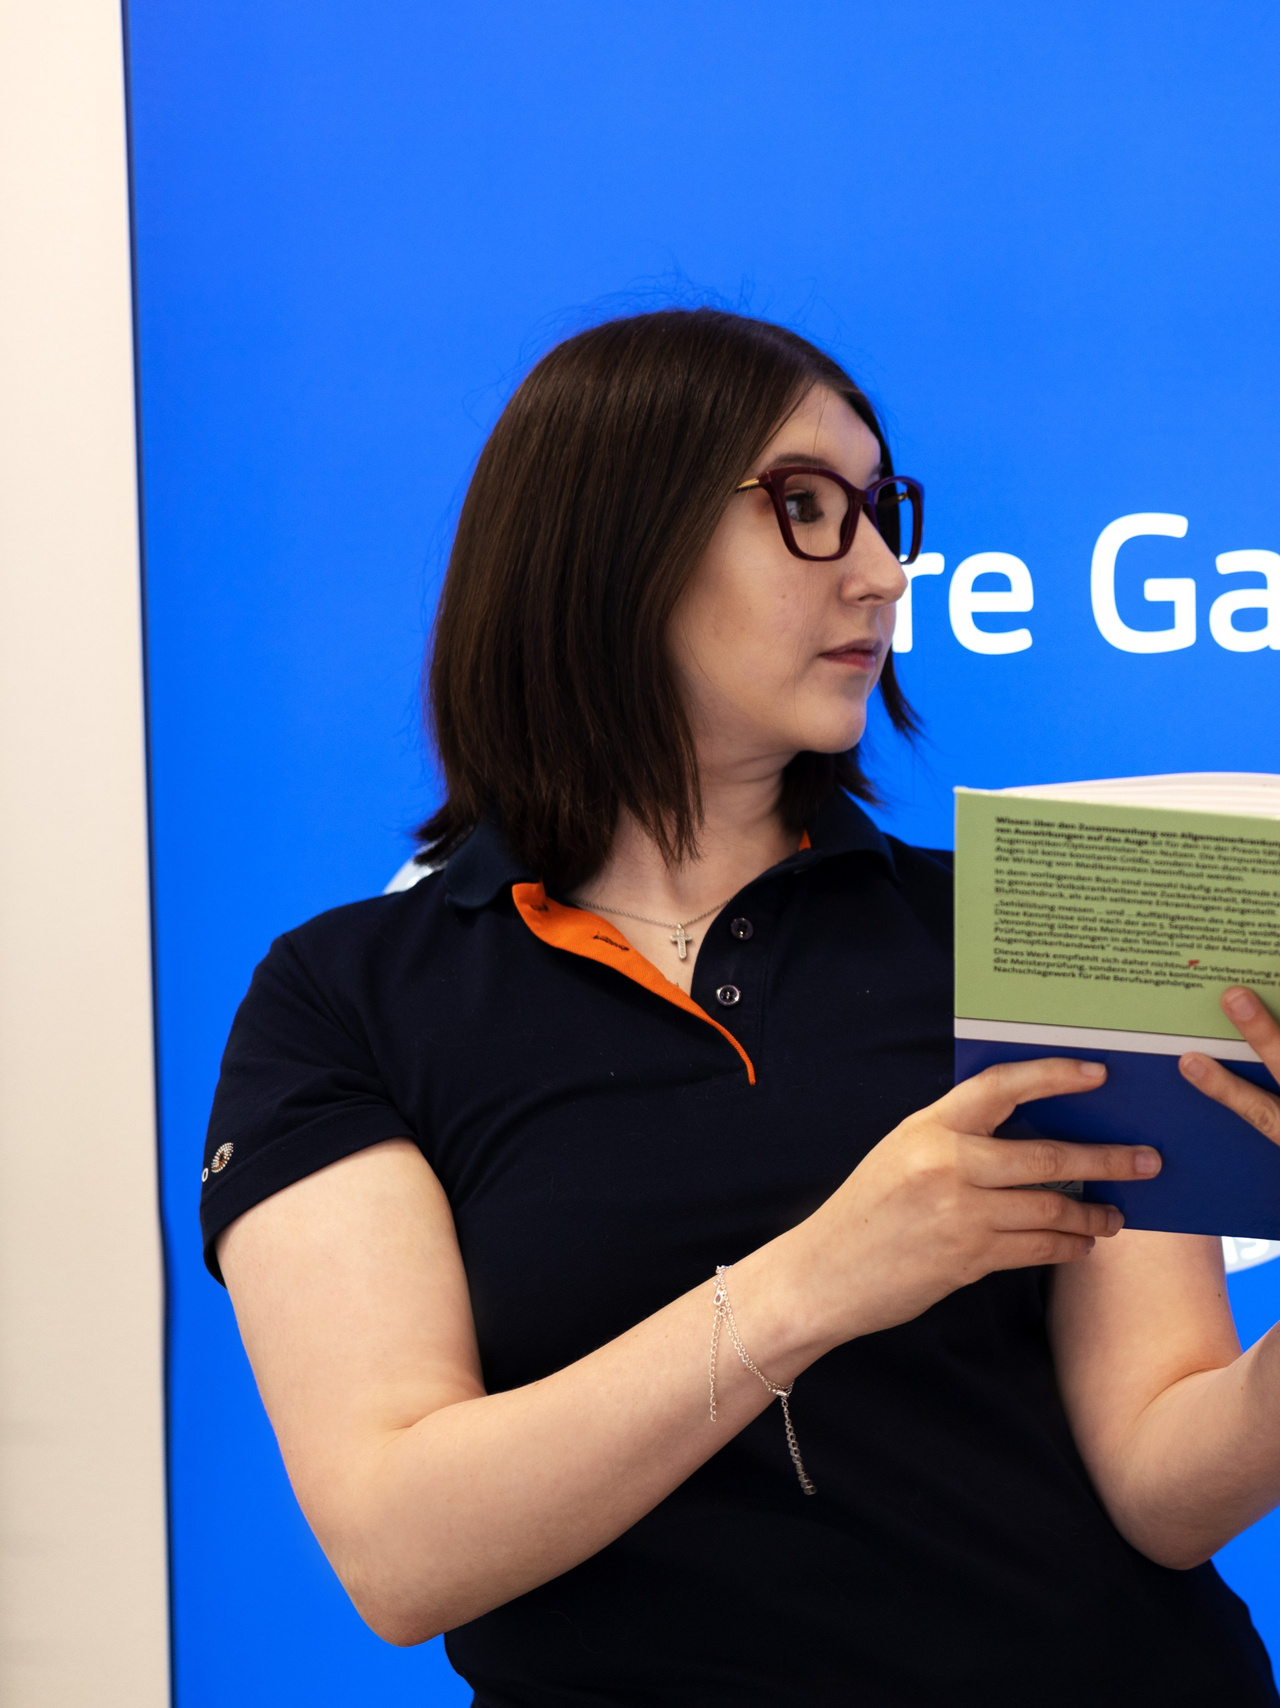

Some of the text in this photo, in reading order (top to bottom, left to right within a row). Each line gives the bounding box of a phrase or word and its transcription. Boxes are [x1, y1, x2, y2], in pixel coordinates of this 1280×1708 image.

[892, 552, 1034, 655] re
[995, 817, 1030, 826] Wissen
[1033, 820, 1055, 828] über
[1058, 822, 1076, 830] den
[1105, 835, 1121, 843] das
[1124, 837, 1148, 847] Auge
[1165, 840, 1178, 848] für
[1181, 841, 1200, 850] den
[1214, 844, 1228, 852] der
[1160, 849, 1196, 859] Nutzen.
[1198, 852, 1214, 860] Die
[995, 854, 1009, 862] die
[1012, 856, 1053, 868] Wirkung
[1206, 873, 1243, 882] werden.
[996, 845, 1025, 855] Auges
[1041, 849, 1067, 858] keine
[1069, 851, 1117, 862] konstante
[1119, 855, 1151, 866] Größe,
[1153, 859, 1193, 868] sondern
[1195, 862, 1219, 870] kann
[1221, 864, 1248, 873] durch
[1007, 869, 1028, 877] dem
[1095, 876, 1119, 884] Buch
[1121, 878, 1141, 886] sind
[1143, 881, 1178, 889] sowohl
[1179, 883, 1211, 894] häufig
[1008, 879, 1053, 888] genannte
[1140, 889, 1157, 897] wie
[1241, 897, 1280, 908] Rheuma
[1069, 892, 1082, 900] als
[1084, 894, 1107, 902] auch
[1109, 896, 1153, 906] seltenere
[995, 908, 1020, 917] Diese
[1022, 910, 1075, 921] Kenntnisse
[1077, 915, 1097, 923] sind
[1124, 919, 1139, 927] der
[1168, 922, 1220, 933] September
[1058, 905, 1094, 914] messen
[1207, 916, 1224, 925] des
[1226, 918, 1255, 928] Auges
[1057, 922, 1078, 930] über
[1081, 924, 1097, 932] das
[1229, 937, 1248, 945] und
[1250, 938, 1271, 947] über
[1121, 936, 1140, 944] den
[1142, 938, 1169, 947] Teilen
[1204, 943, 1219, 951] der
[994, 947, 1024, 956] Dieses
[1026, 950, 1050, 958] Werk
[1052, 953, 1098, 962] empfiehlt
[1101, 956, 1119, 964] sich
[1121, 957, 1148, 966] daher
[993, 956, 1008, 964] die
[1089, 965, 1127, 974] sondern
[1129, 968, 1152, 976] auch
[1241, 976, 1276, 986] Lektüre
[1094, 973, 1111, 981] alle
